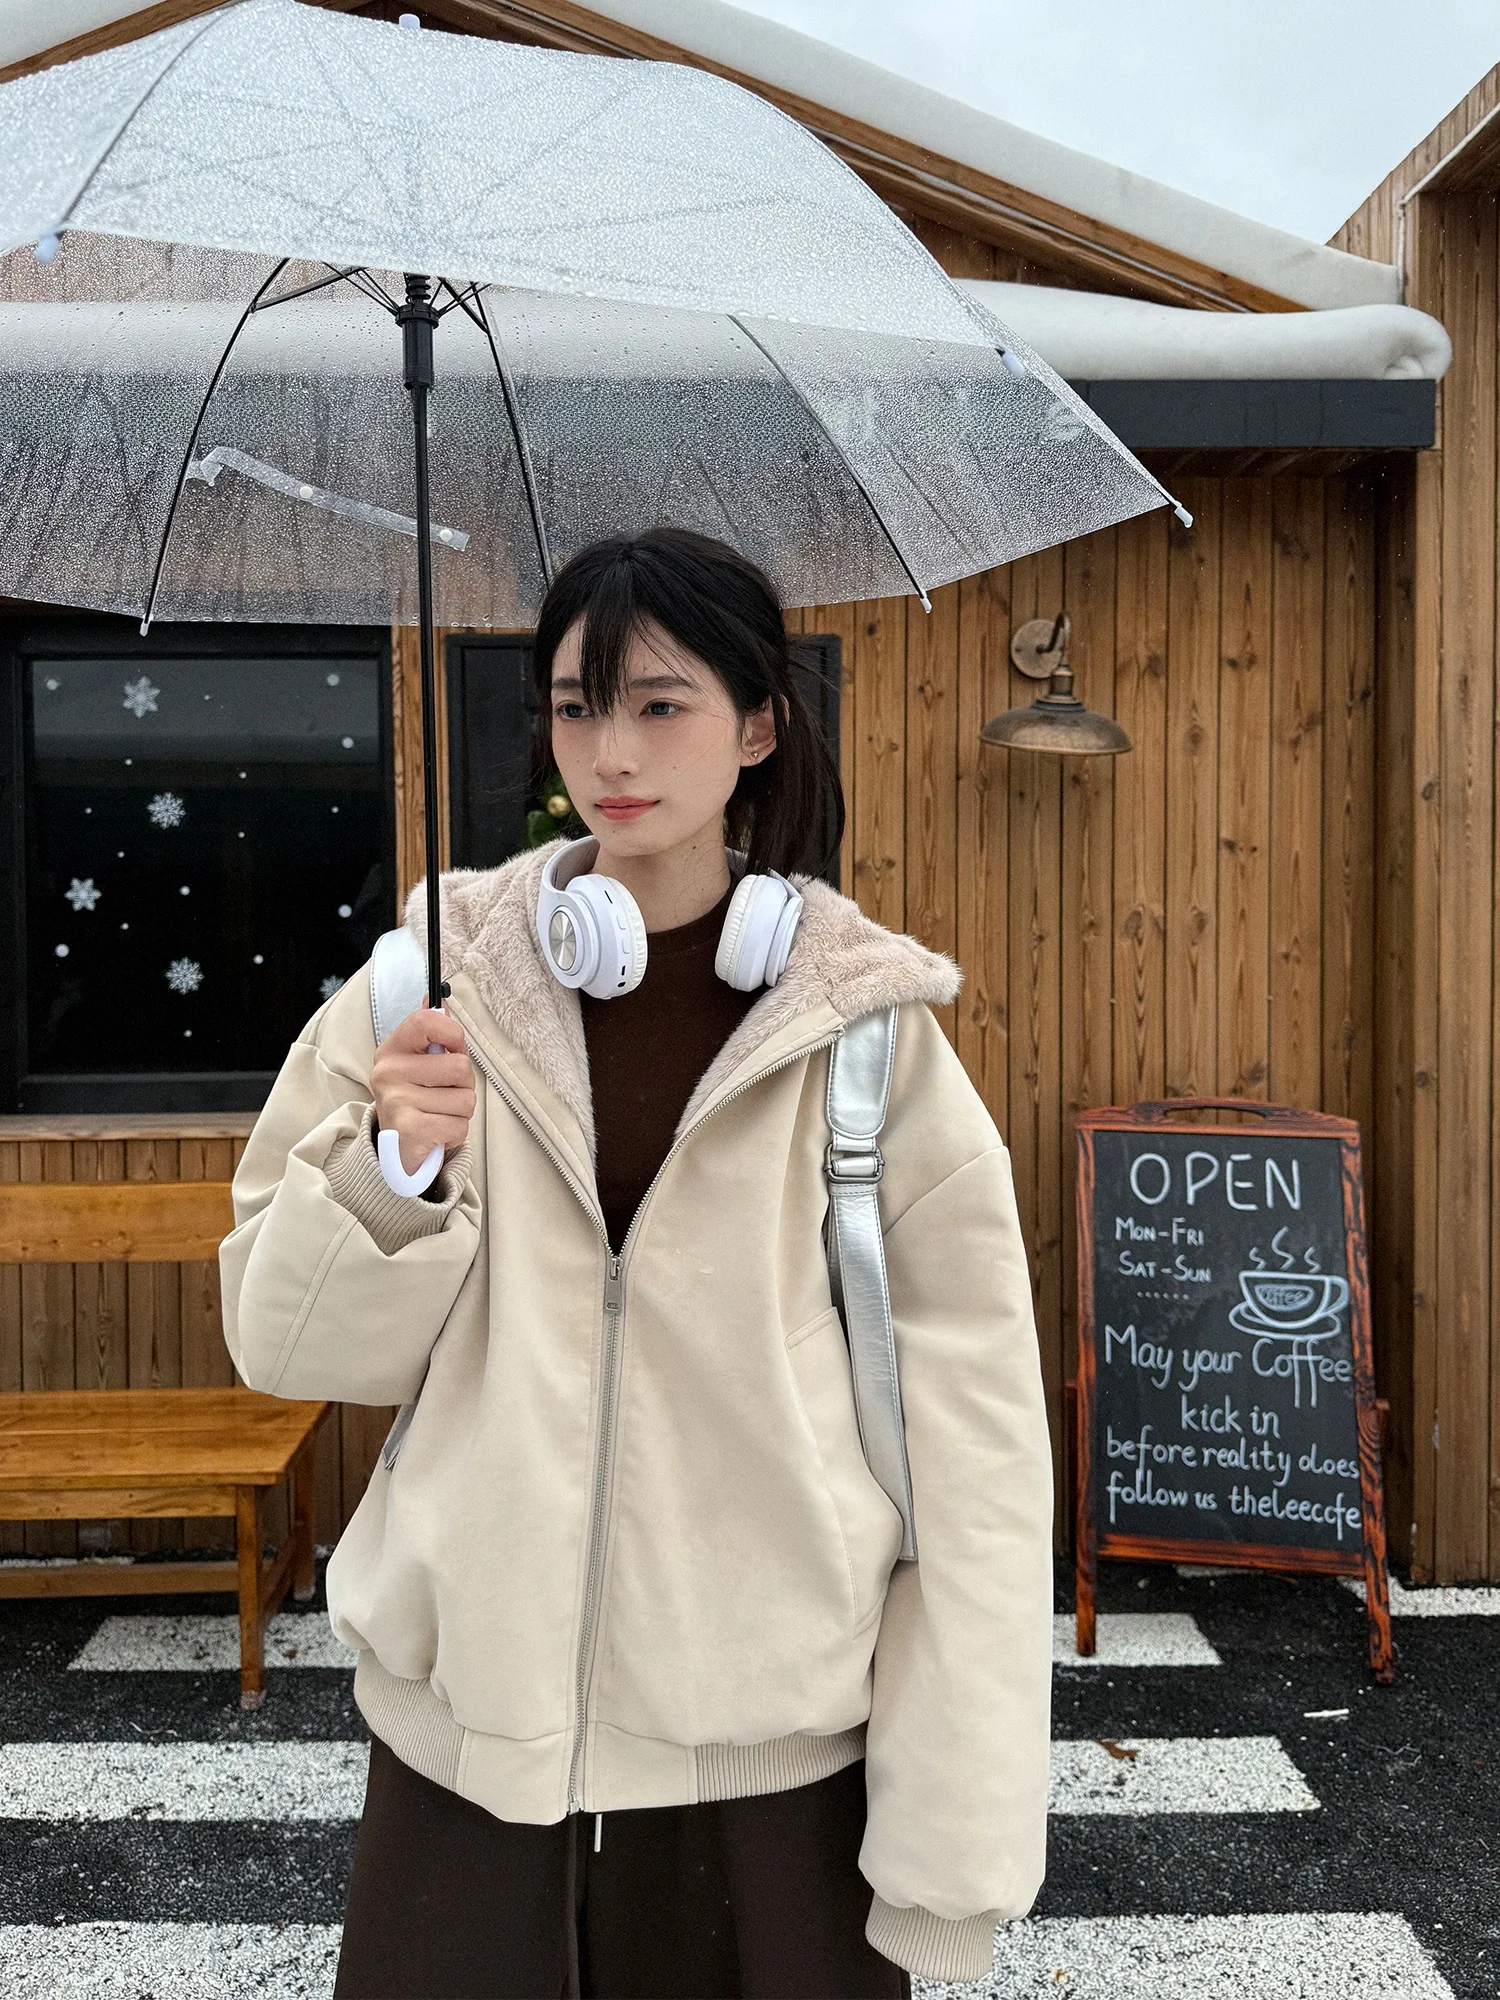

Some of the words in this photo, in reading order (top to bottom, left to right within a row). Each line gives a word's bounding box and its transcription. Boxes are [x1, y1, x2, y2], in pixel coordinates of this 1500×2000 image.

[1130, 1151, 1301, 1211] OPEN
[1105, 1324, 1174, 1390] May
[1178, 1348, 1243, 1392] your
[1252, 1337, 1352, 1408] Coffee
[1181, 1394, 1243, 1433] kick
[1249, 1405, 1281, 1439] in
[1106, 1424, 1197, 1482] before
[1202, 1436, 1291, 1487] reality
[1299, 1442, 1360, 1479] does
[1106, 1467, 1188, 1525] follow
[1194, 1491, 1218, 1510] us
